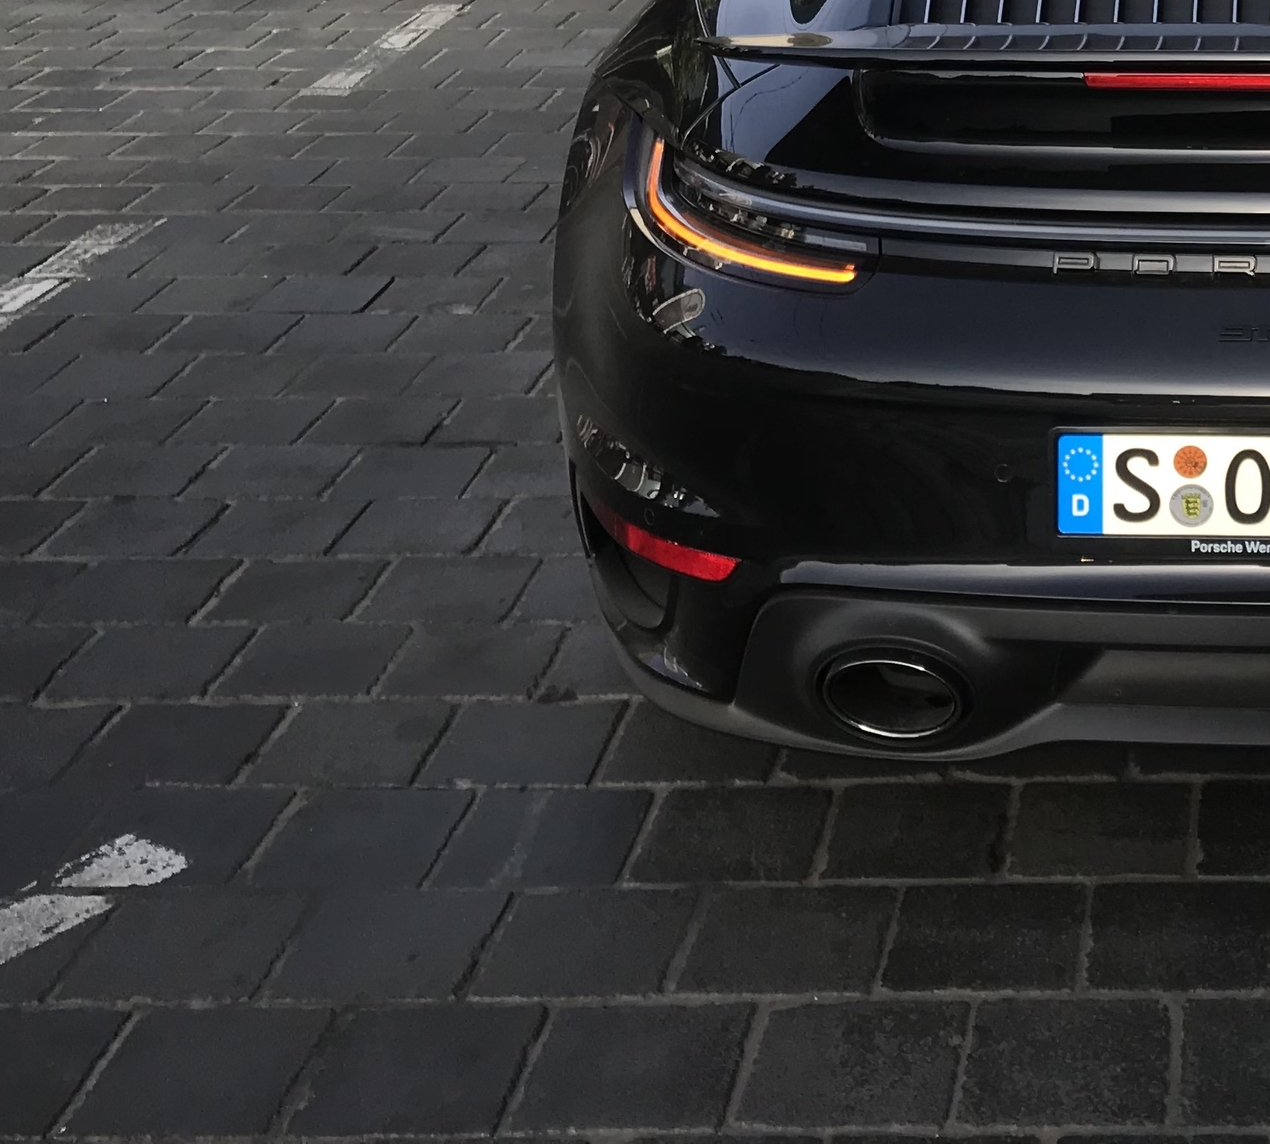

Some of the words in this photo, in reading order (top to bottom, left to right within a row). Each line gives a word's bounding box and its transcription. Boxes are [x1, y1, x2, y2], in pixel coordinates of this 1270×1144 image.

[1071, 493, 1089, 517] D
[1112, 447, 1161, 523] S
[1190, 540, 1243, 554] Porsche
